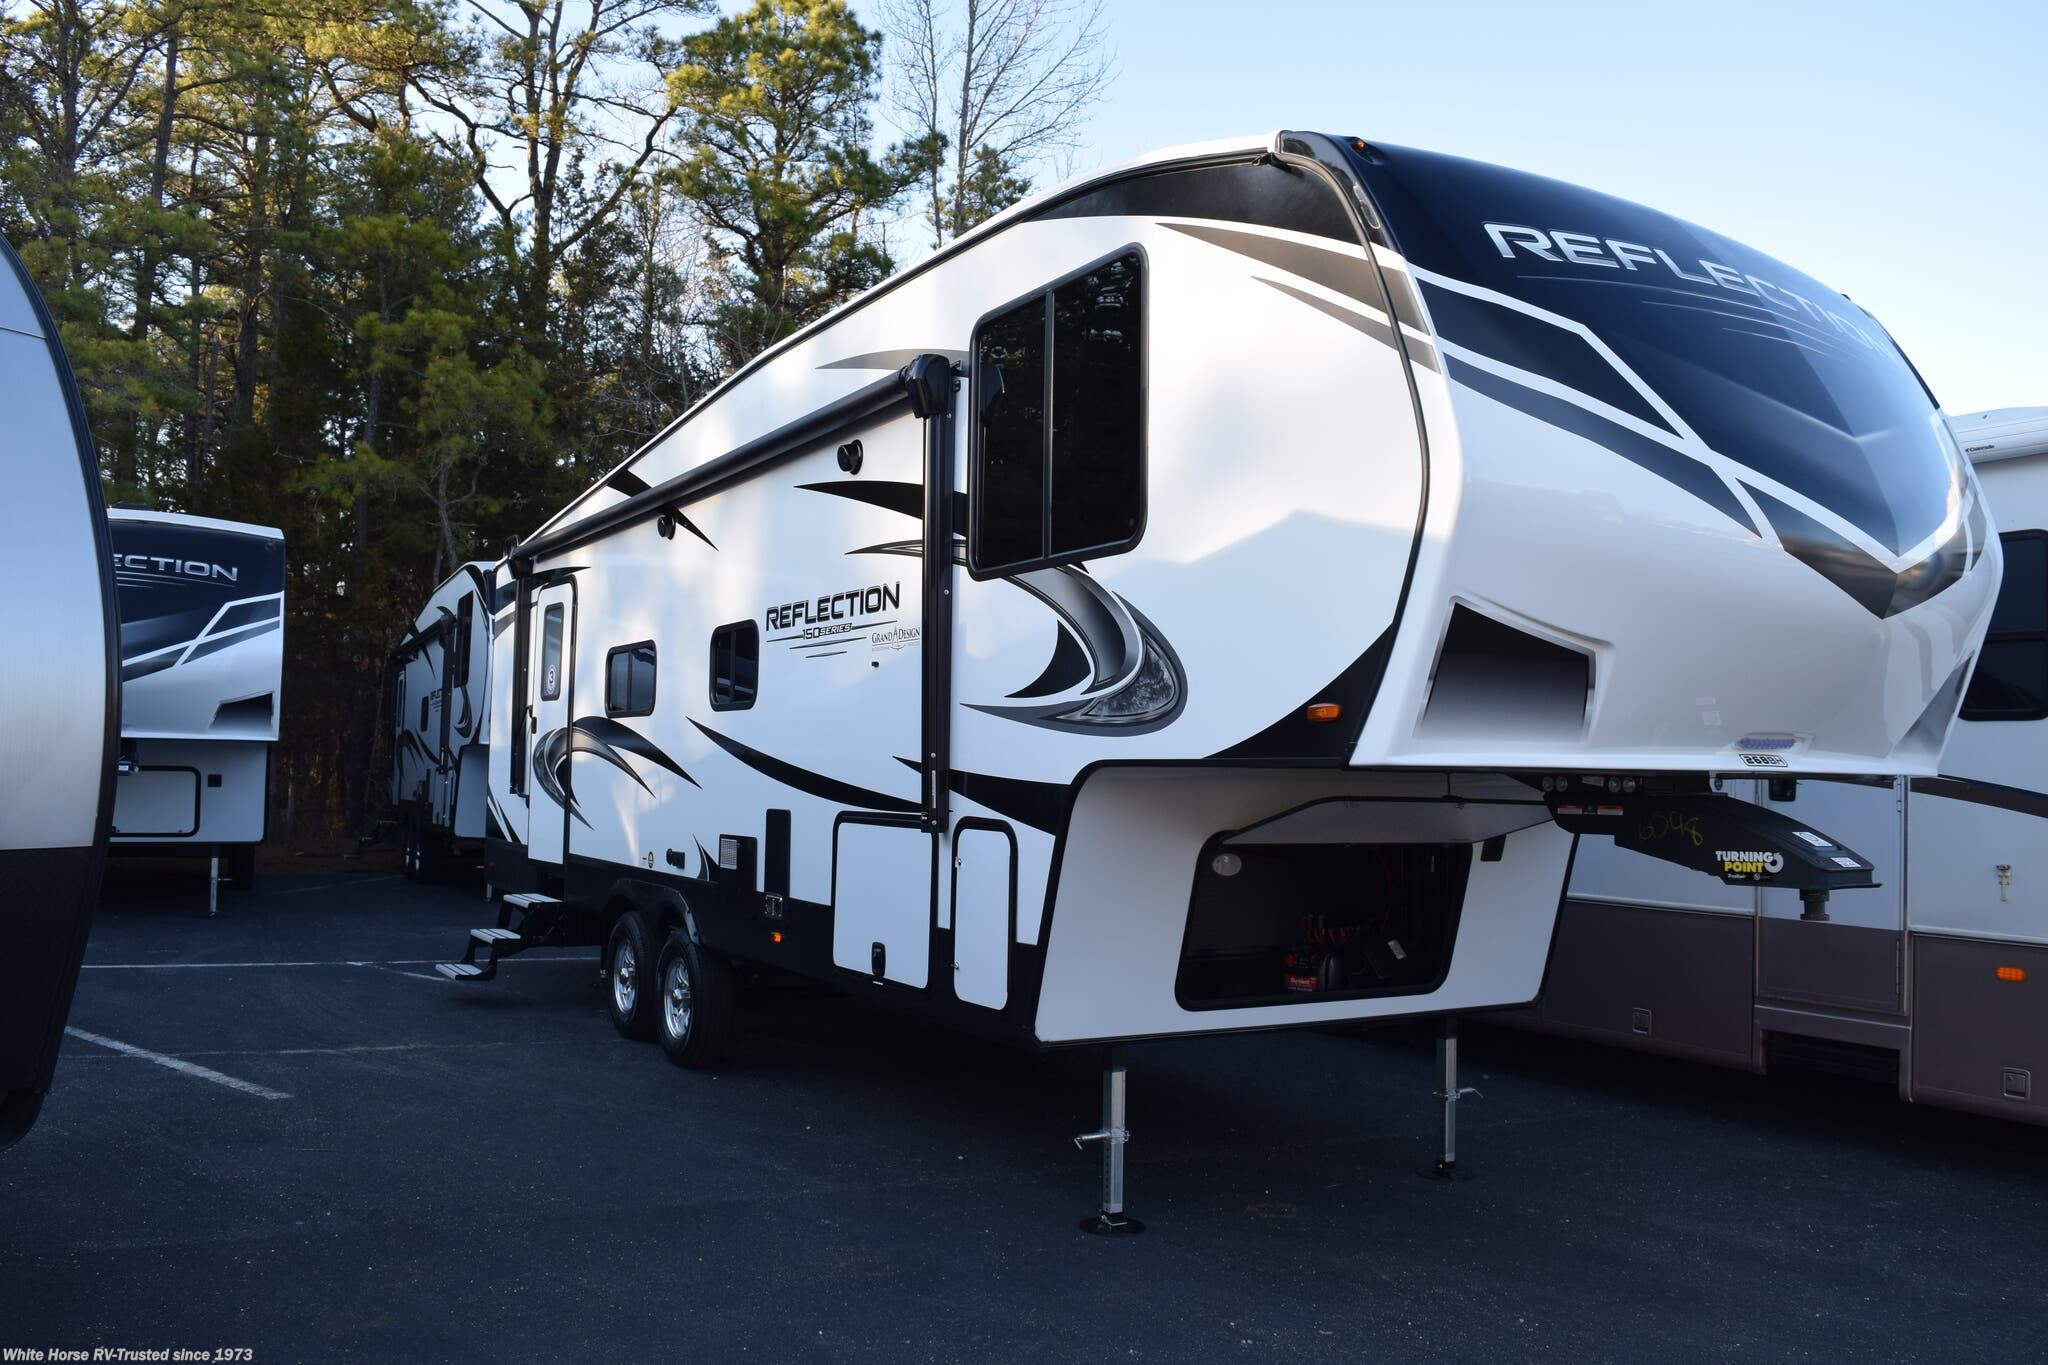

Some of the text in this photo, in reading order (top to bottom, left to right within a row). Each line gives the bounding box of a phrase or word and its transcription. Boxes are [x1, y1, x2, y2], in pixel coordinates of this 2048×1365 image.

[1483, 221, 1898, 363] REFLECTION
[766, 581, 900, 631] REFLECTION
[803, 622, 852, 640] 150 SERIES
[1715, 850, 1774, 862] TURNING
[1724, 861, 1764, 873] POINT
